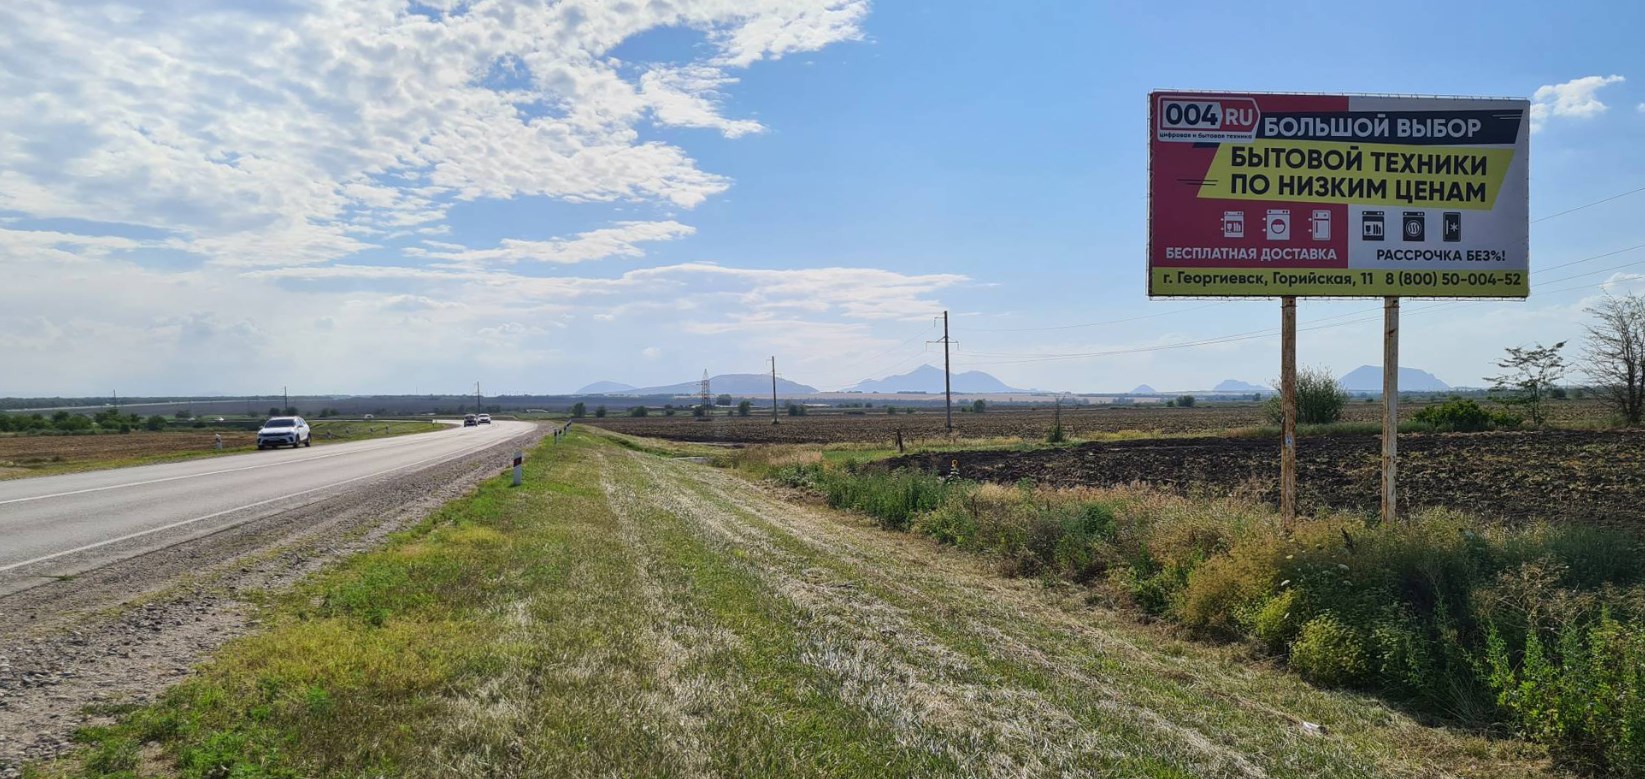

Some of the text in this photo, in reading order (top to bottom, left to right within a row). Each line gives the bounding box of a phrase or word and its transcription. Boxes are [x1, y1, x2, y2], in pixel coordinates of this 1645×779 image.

[1165, 103, 1253, 126] 004 RU
[1264, 113, 1482, 138] БОЛЬШОЙ ВЫБОР
[1231, 145, 1487, 176] БЫТОВОЙ ТЕХНИКИ
[1231, 173, 1486, 204] ПО НИЗКИМ ЦЕНАМ
[1165, 247, 1337, 261] БЕСПЛАТНАЯ ДОСТАВКА
[1376, 249, 1462, 261] РАССРОЧКА
[1163, 271, 1373, 287] г. Георгиевск, Горийская, 11
[1385, 271, 1521, 287] 8 (800) 50-004-52
